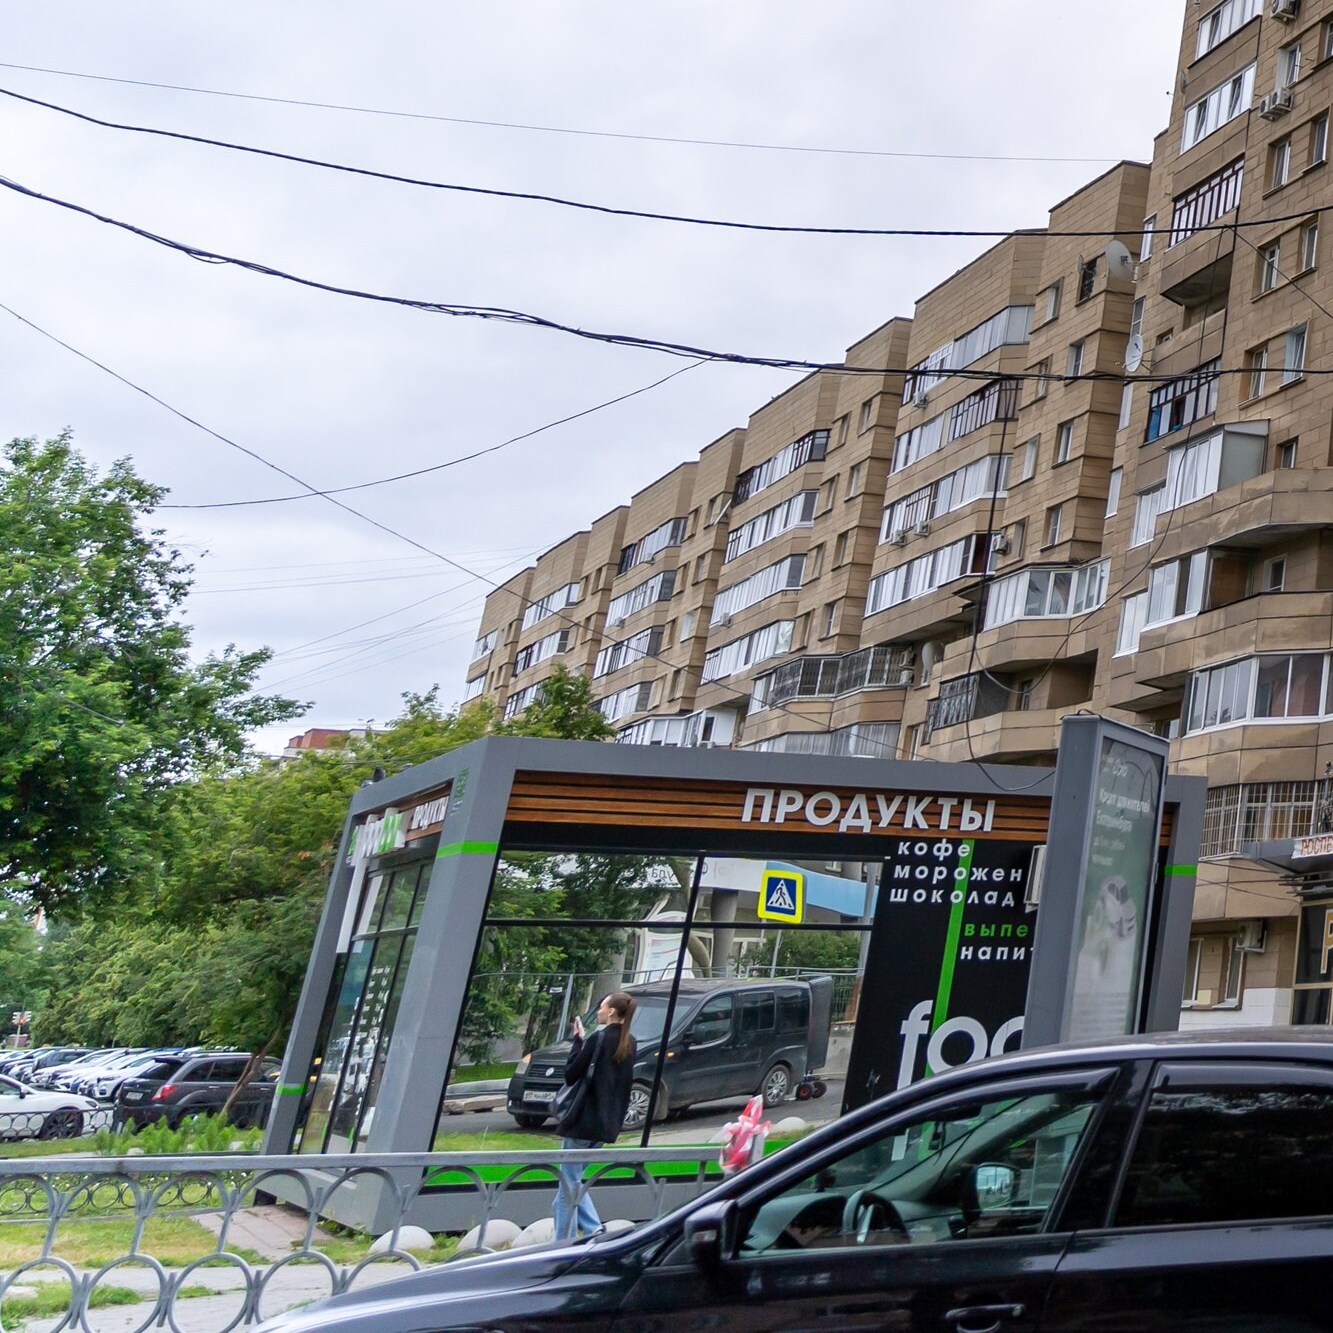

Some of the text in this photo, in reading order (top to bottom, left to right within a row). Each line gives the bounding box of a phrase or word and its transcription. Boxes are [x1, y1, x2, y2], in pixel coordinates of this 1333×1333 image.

[741, 788, 997, 833] ПРОДУКТЫ
[898, 838, 971, 860] кофе
[894, 864, 1023, 884] морожен
[890, 887, 1015, 907] шоколад
[964, 923, 1029, 938] выпе
[960, 946, 1034, 960] напи
